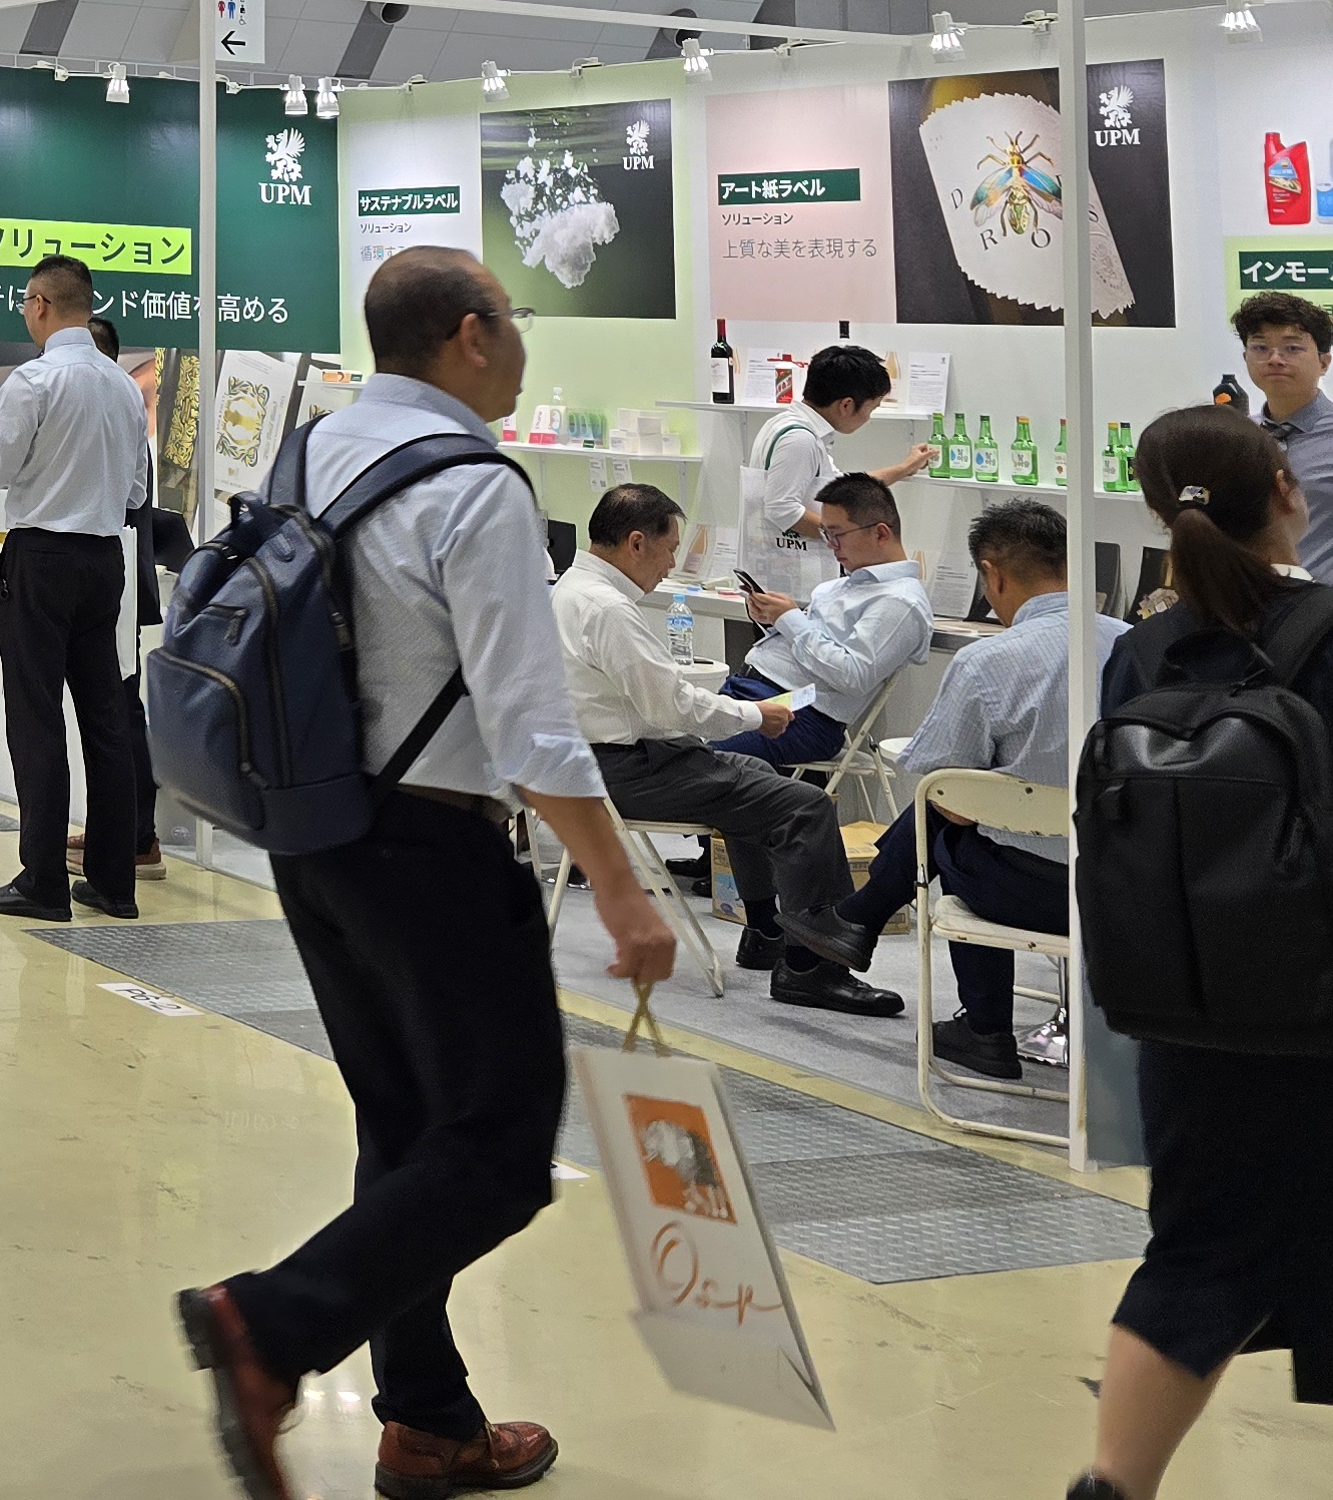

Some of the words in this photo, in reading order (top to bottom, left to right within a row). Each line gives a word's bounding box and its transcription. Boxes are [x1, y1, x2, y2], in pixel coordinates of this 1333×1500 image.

[1094, 127, 1141, 147] UPM
[622, 155, 655, 171] UPM
[258, 181, 312, 206] UPM
[720, 178, 826, 200] アート紙ラベル
[359, 192, 459, 212] サステナブルラベル
[360, 222, 412, 234] ソリューション
[721, 211, 794, 226] ソリューション
[721, 237, 877, 260] 上質な美を表現する
[1242, 260, 1333, 284] インモー
[775, 536, 808, 551] UPM
